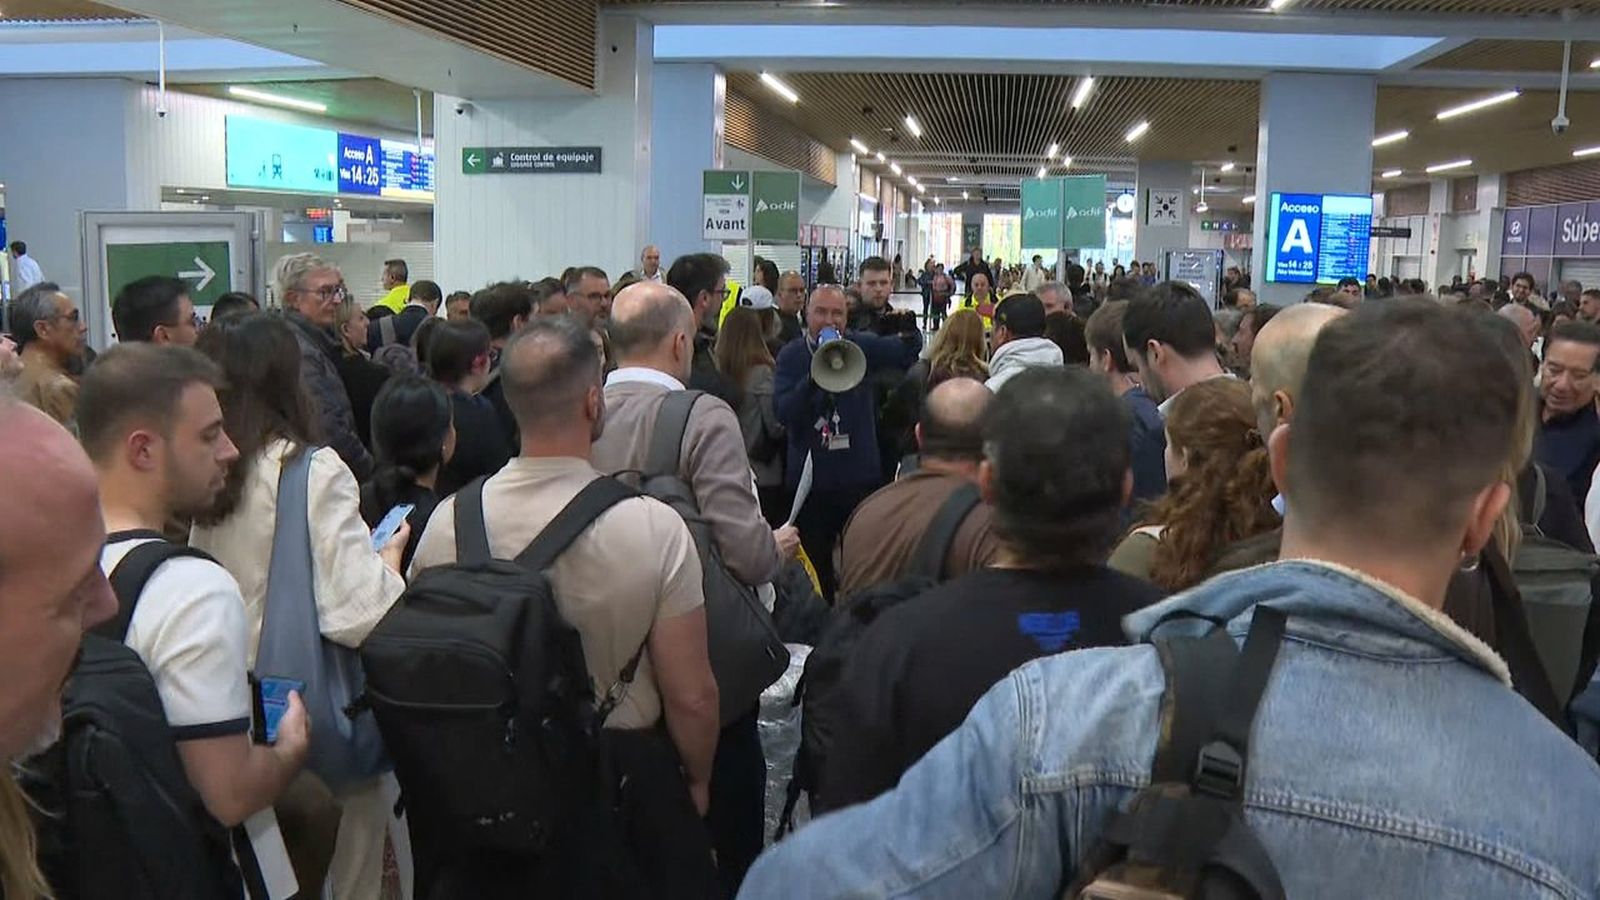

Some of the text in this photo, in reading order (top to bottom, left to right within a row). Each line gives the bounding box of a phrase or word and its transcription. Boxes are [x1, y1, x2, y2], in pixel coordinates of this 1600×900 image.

[344, 144, 374, 166] Acceso A
[510, 152, 594, 163] Control de equipaje
[1281, 202, 1319, 213] Acceso
[706, 218, 745, 230] Avant
[1562, 214, 1600, 242] Súbe
[1281, 218, 1313, 254] A
